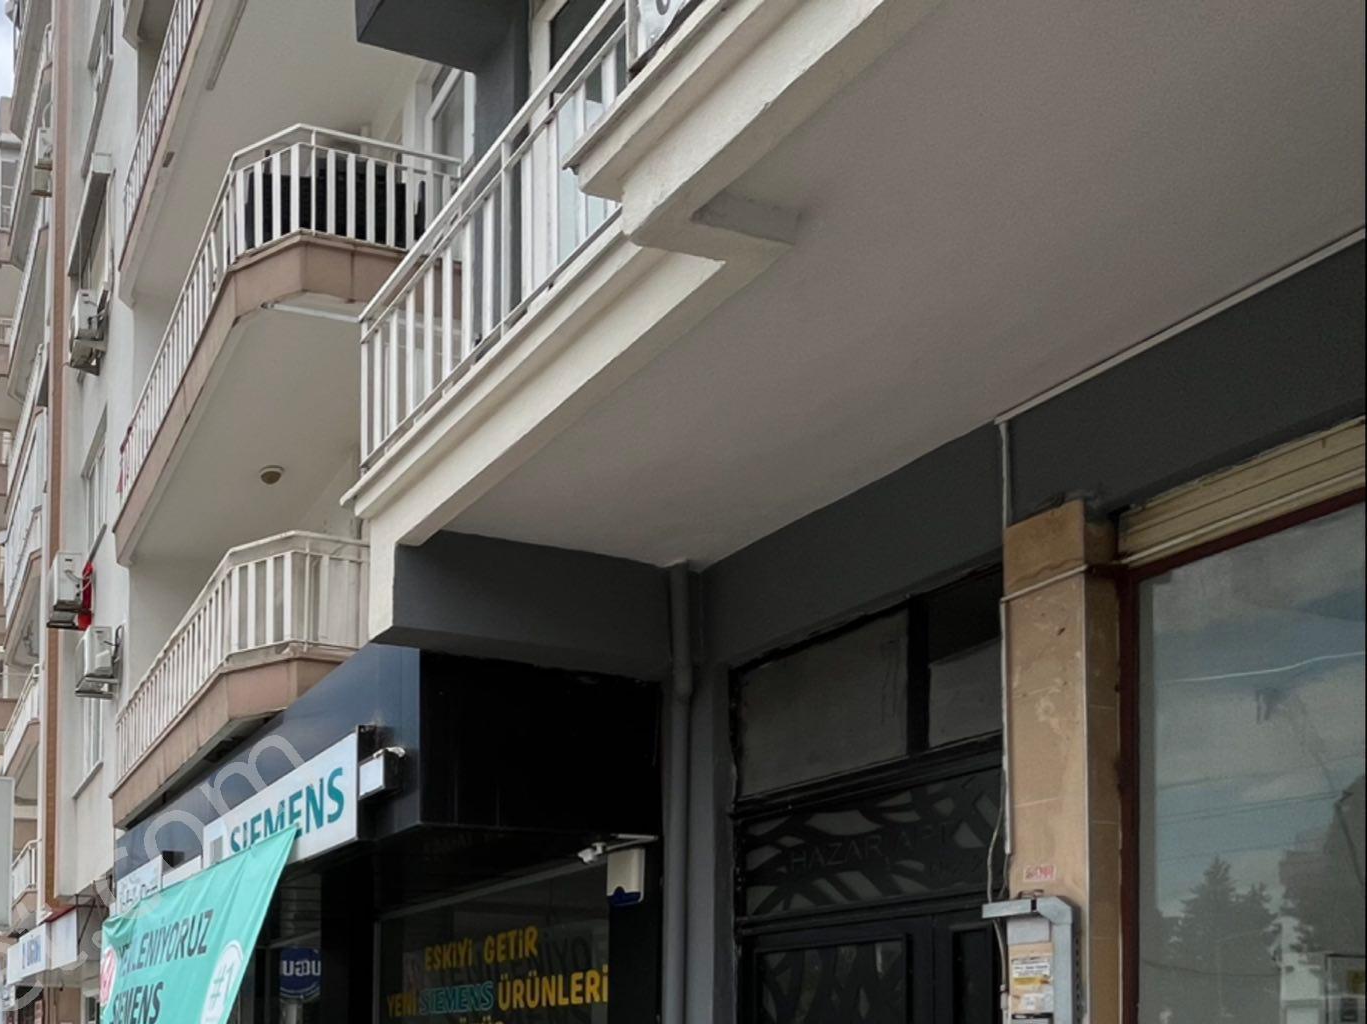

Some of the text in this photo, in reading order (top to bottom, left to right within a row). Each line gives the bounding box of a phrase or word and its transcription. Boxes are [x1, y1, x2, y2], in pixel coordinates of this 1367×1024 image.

[230, 768, 345, 852] SIEMENS
[484, 927, 538, 964] GETİR
[419, 980, 494, 1016] SIEMENS
[498, 964, 609, 1011] ÜRÜNLERİ
